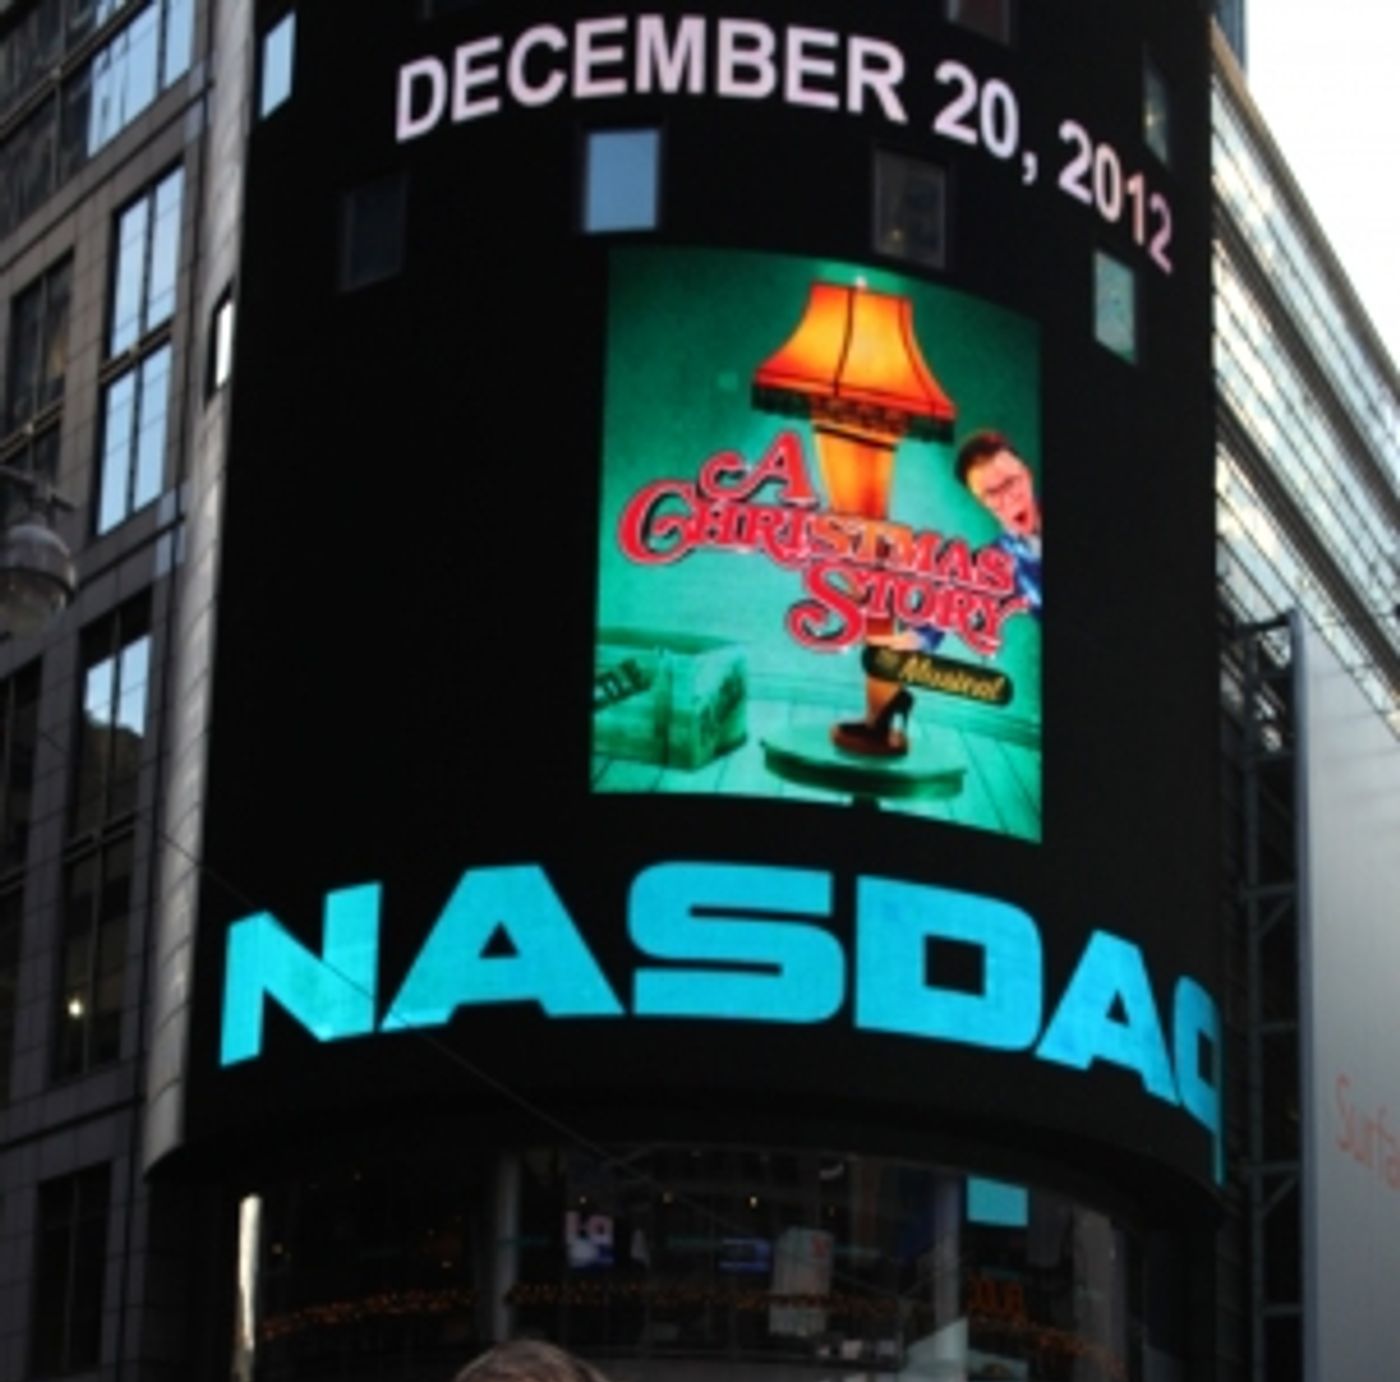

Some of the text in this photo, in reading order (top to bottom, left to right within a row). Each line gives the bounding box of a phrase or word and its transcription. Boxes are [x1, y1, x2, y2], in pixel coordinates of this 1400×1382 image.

[395, 15, 1173, 274] DECEMBER 20, 2012
[700, 430, 818, 504] A
[784, 560, 1029, 657] STORY
[220, 861, 1223, 1184] NASDAQ
